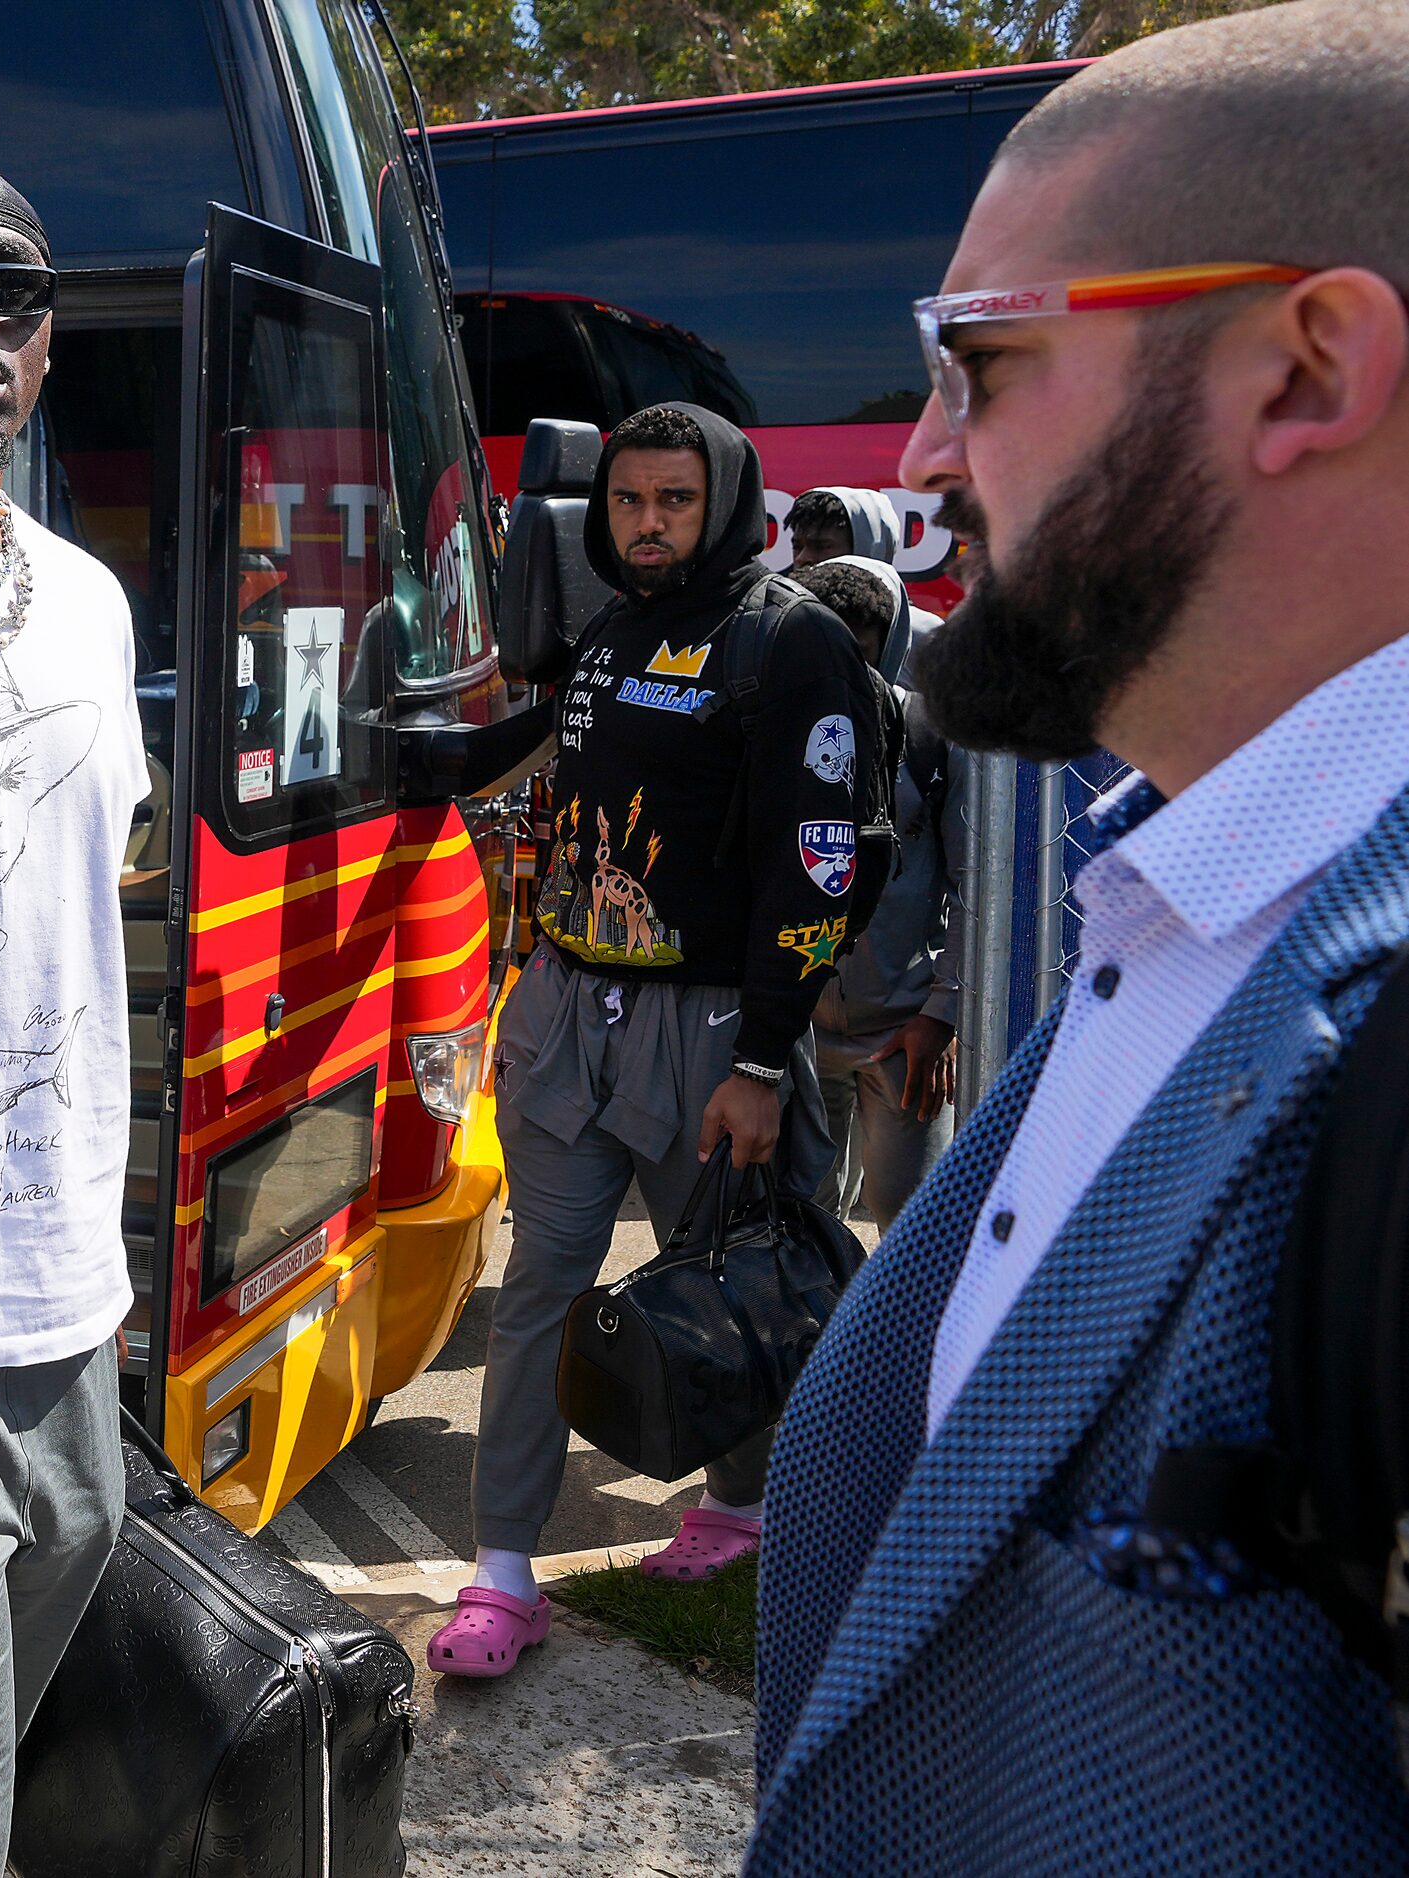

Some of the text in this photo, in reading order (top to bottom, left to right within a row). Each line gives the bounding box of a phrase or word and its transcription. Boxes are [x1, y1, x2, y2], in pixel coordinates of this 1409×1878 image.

[300, 687, 323, 769] 4
[242, 750, 271, 769] NOTICE
[805, 826, 821, 843] FC
[243, 1235, 323, 1310] FIRE EXTINGUISHER INSIDE
